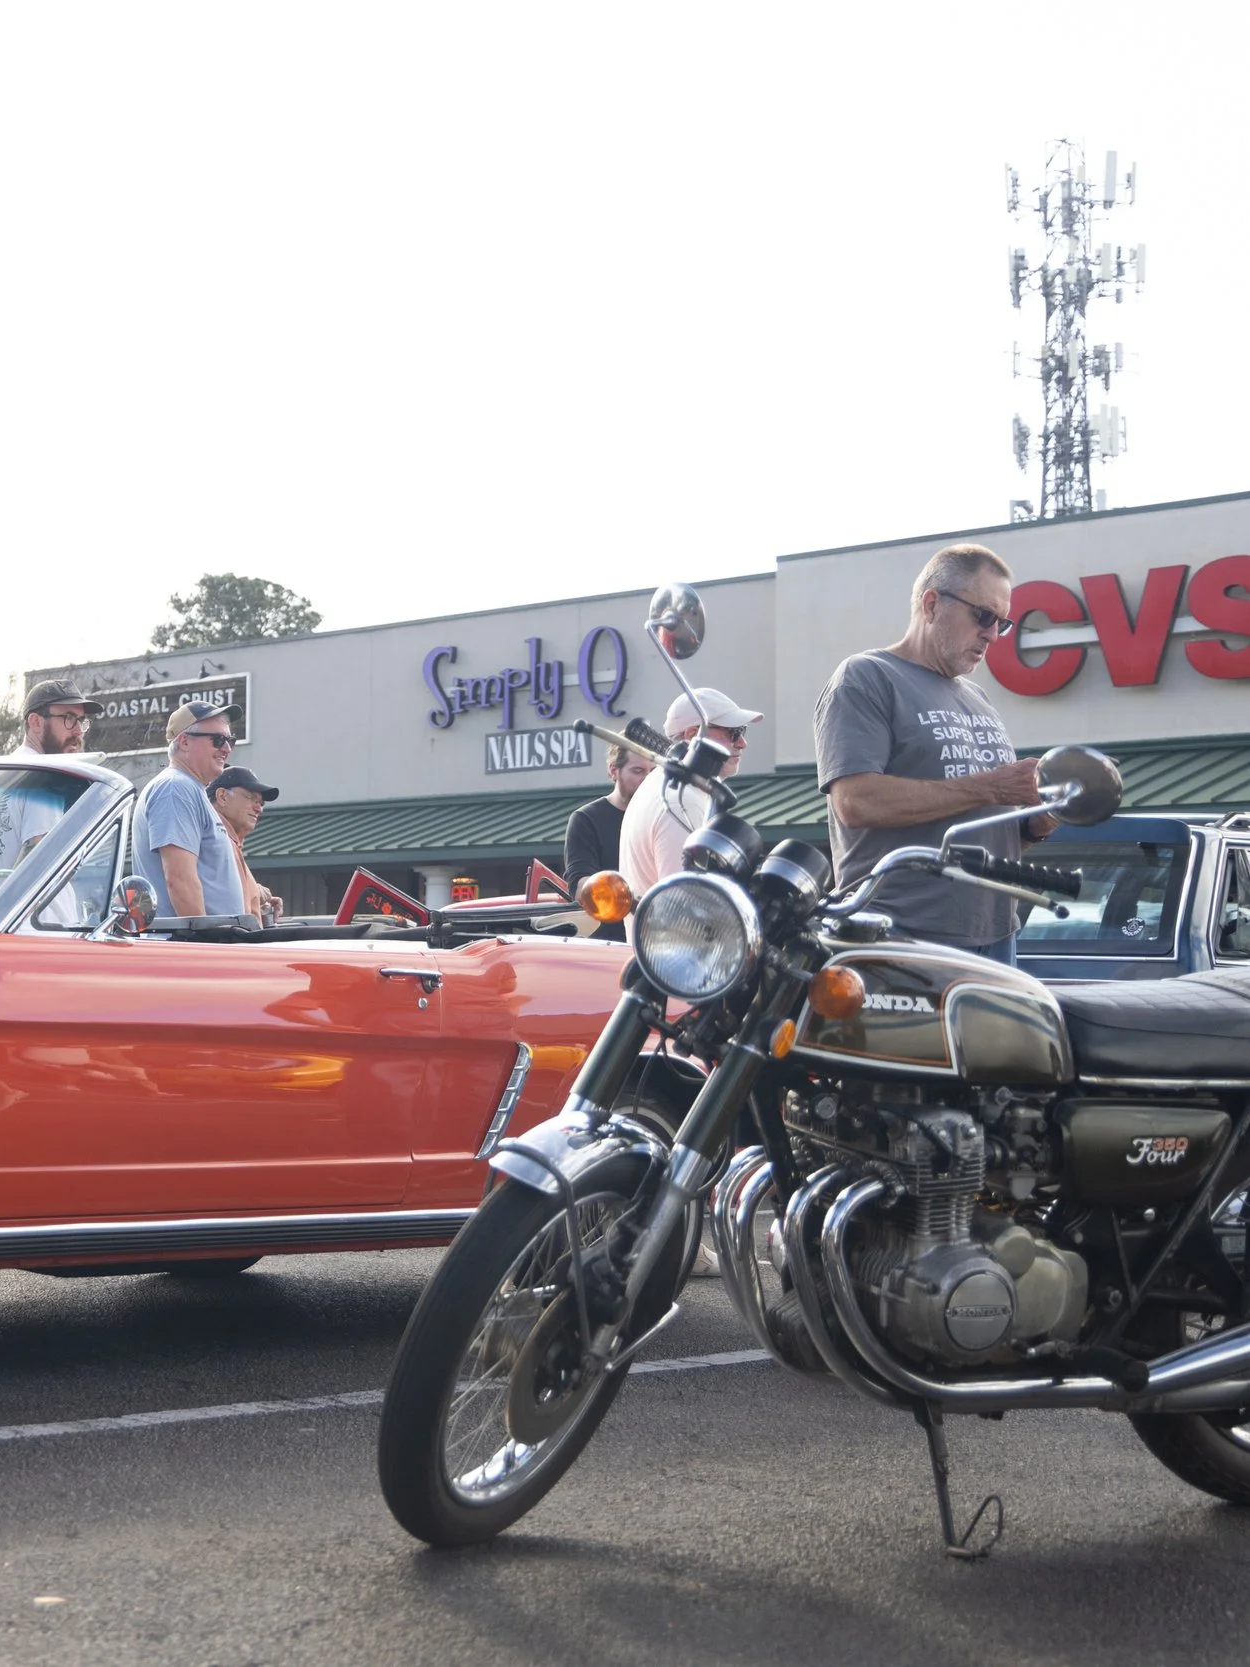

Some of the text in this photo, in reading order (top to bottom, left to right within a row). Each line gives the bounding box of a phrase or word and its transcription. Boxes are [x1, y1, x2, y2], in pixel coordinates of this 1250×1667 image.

[985, 555, 1250, 697] CVS
[422, 626, 628, 730] Simply Q
[918, 710, 959, 725] LET'S
[959, 713, 997, 729] WAKE
[932, 727, 1012, 746] SUPER EARL
[487, 729, 589, 771] NAILS SPA
[940, 745, 972, 760] AND
[973, 749, 995, 763] GO
[862, 993, 934, 1013] ONDA
[1126, 1138, 1186, 1164] Four
[1152, 1137, 1189, 1150] 350
